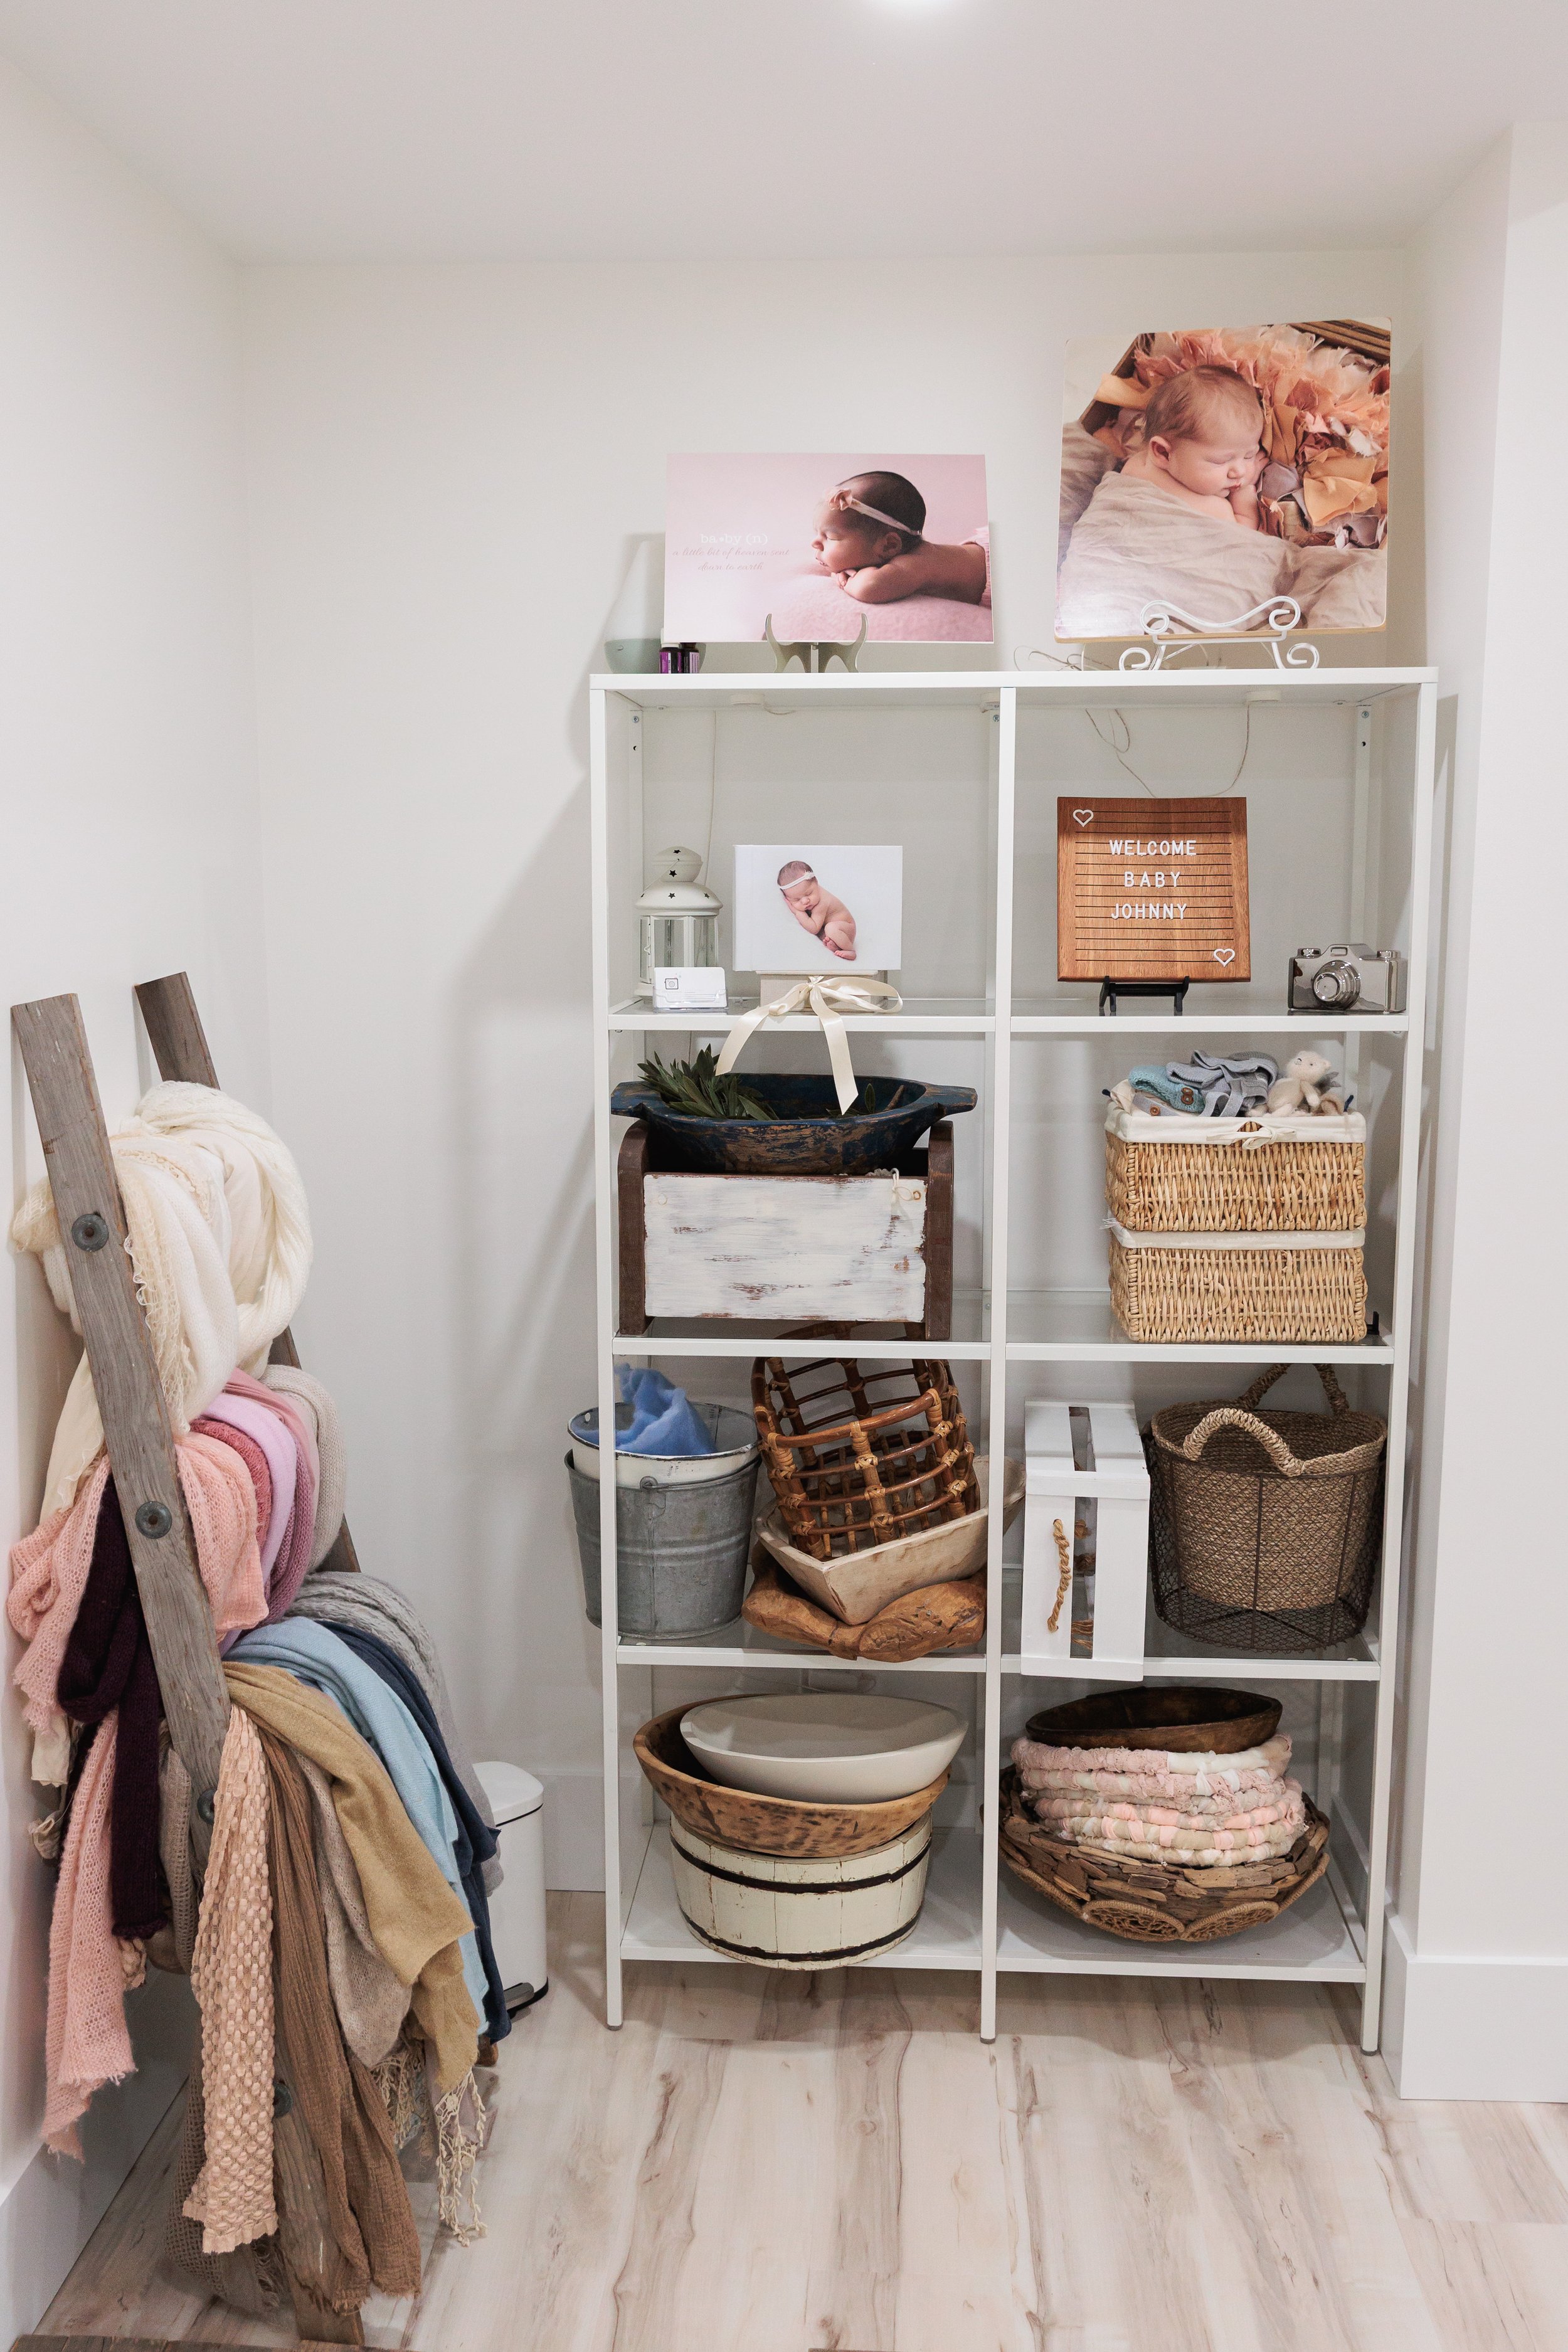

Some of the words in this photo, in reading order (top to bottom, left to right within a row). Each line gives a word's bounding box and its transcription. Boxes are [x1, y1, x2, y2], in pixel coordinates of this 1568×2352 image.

[746, 533, 768, 546] (n)
[682, 547, 704, 556] little
[707, 547, 720, 556] bit
[722, 548, 734, 559] of
[734, 548, 768, 556] heaven
[697, 562, 723, 571] down
[737, 562, 764, 570] earth
[1109, 839, 1197, 857] WELCOME
[1123, 871, 1181, 889] BABY
[1111, 903, 1188, 920] JOHNNY
